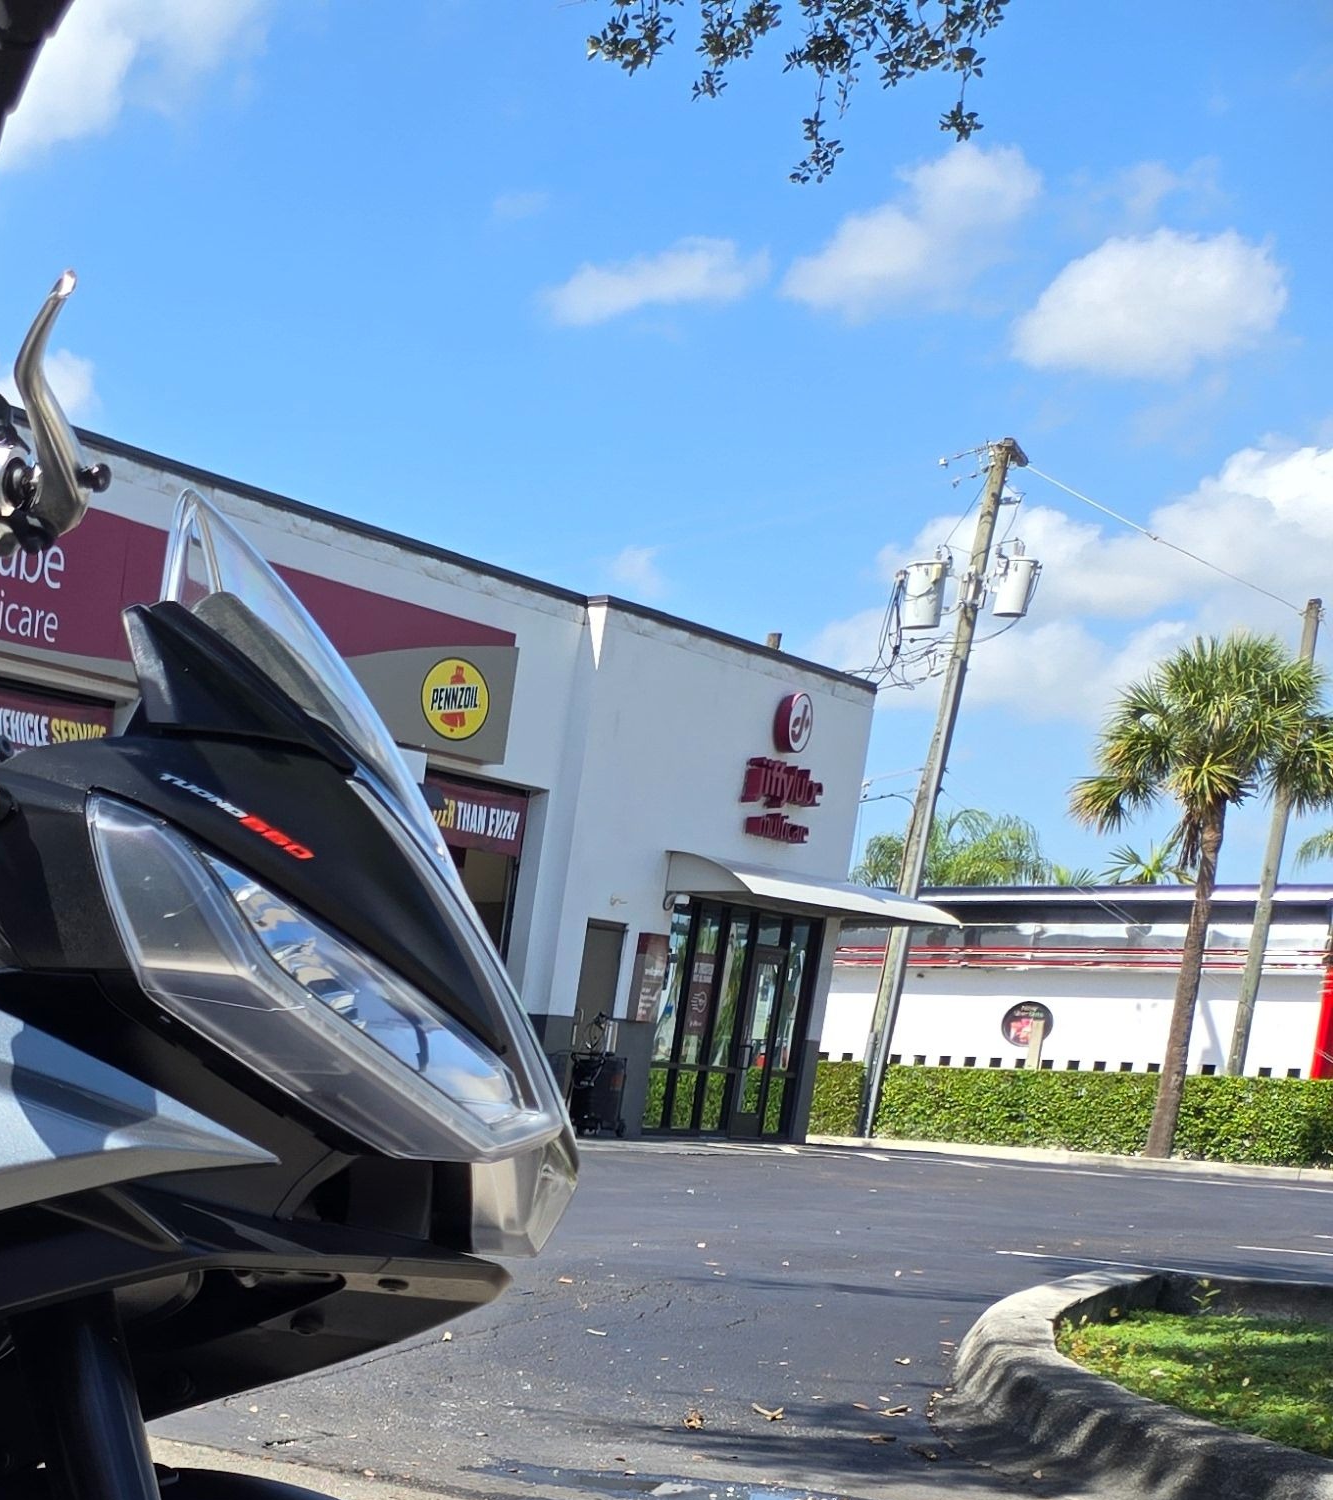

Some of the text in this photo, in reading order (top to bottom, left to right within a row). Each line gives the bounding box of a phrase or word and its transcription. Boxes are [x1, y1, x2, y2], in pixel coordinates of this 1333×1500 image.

[430, 685, 480, 711] PENNZOIL
[159, 772, 249, 819] TUONO
[456, 800, 488, 836] THAN
